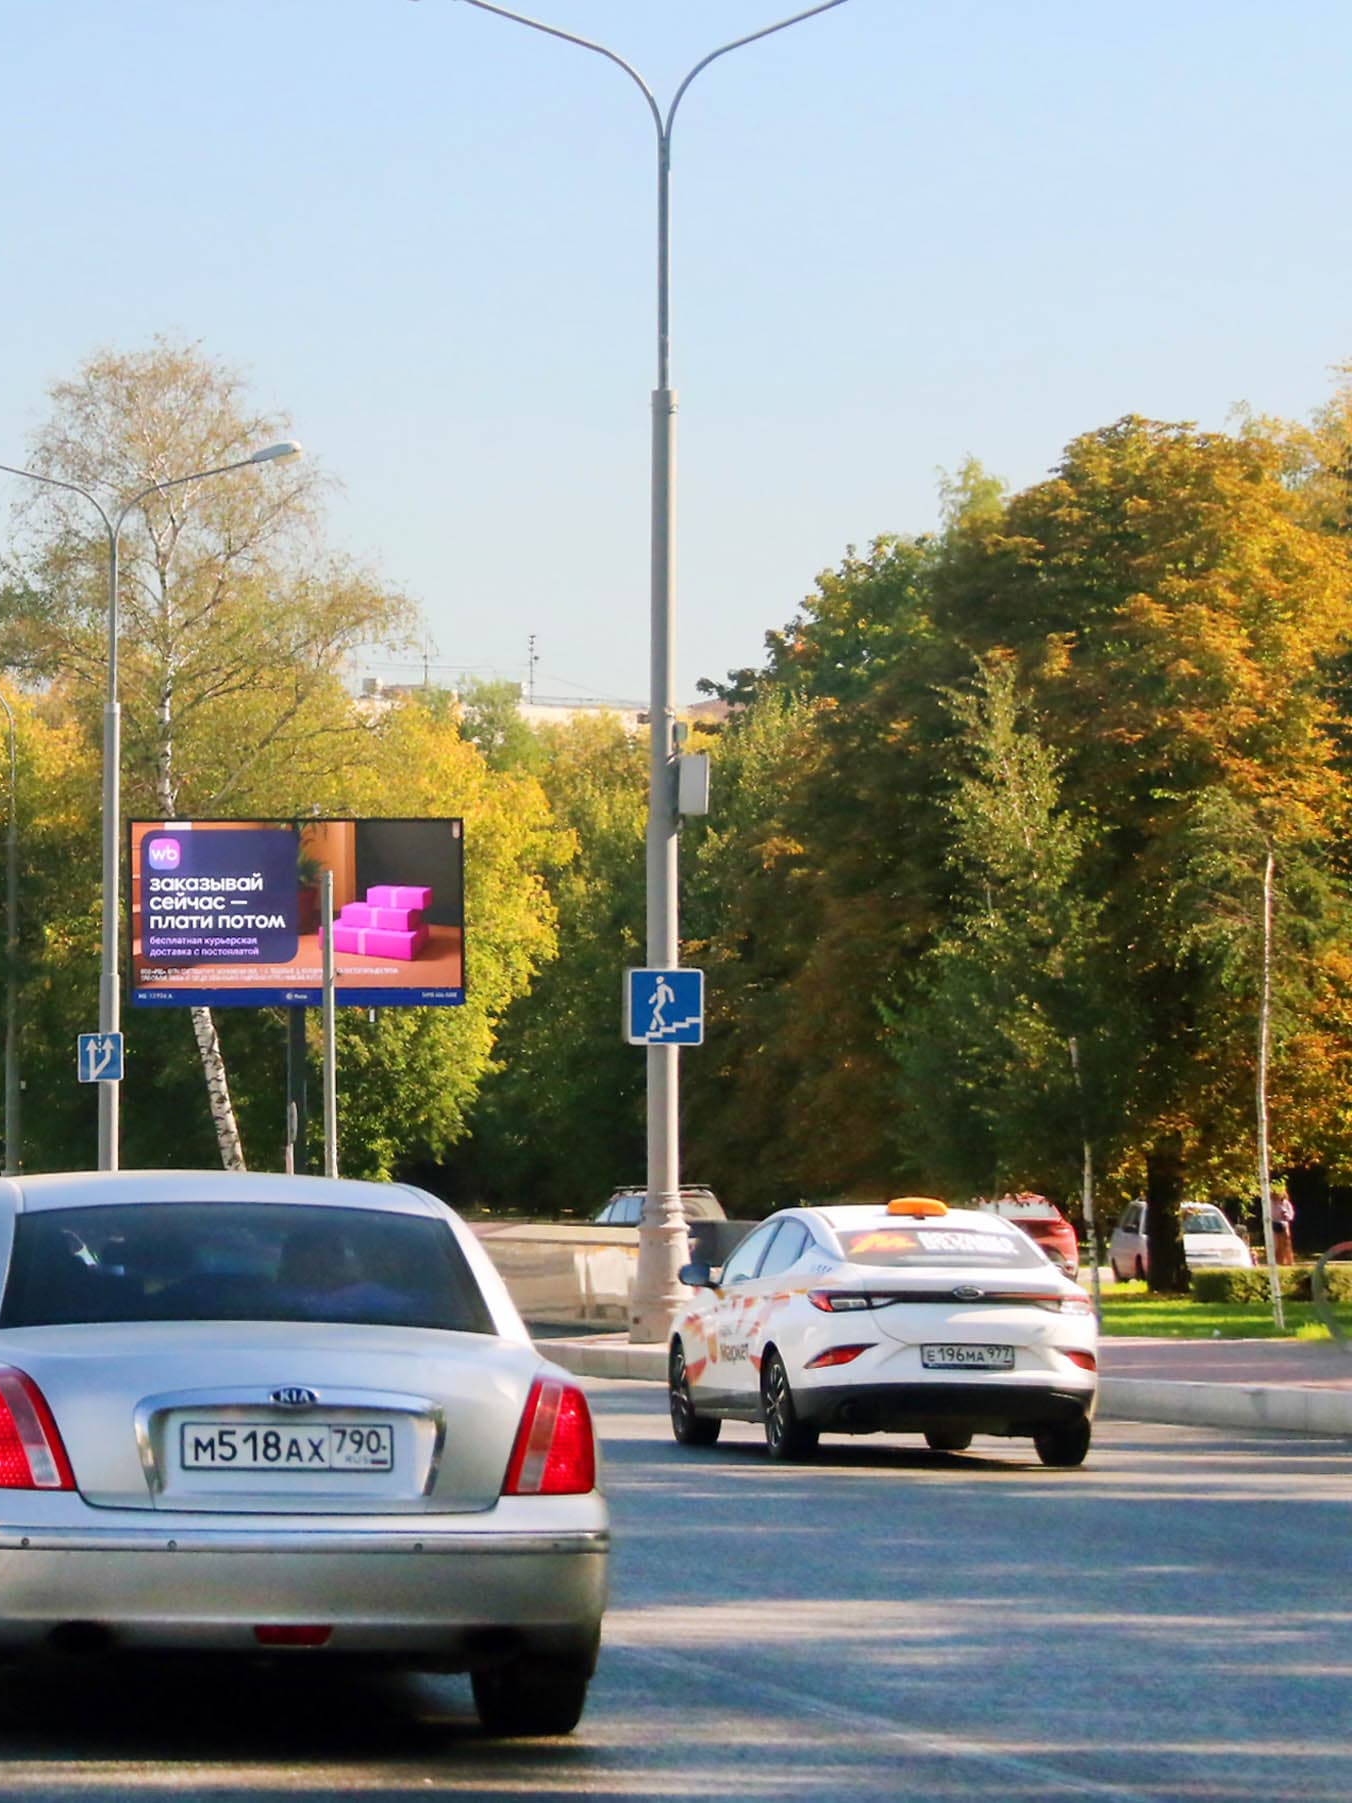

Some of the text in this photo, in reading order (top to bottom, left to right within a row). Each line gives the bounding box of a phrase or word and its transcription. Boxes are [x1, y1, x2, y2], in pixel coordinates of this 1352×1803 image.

[151, 846, 178, 861] wb
[149, 873, 263, 891] заказывай
[149, 893, 225, 910] сейчас
[149, 915, 286, 929] плати потом
[149, 936, 258, 947] бесплатная курьерская
[149, 948, 192, 957] доставка
[279, 1390, 311, 1403] KIA
[194, 1429, 381, 1462] М518АХ 790
